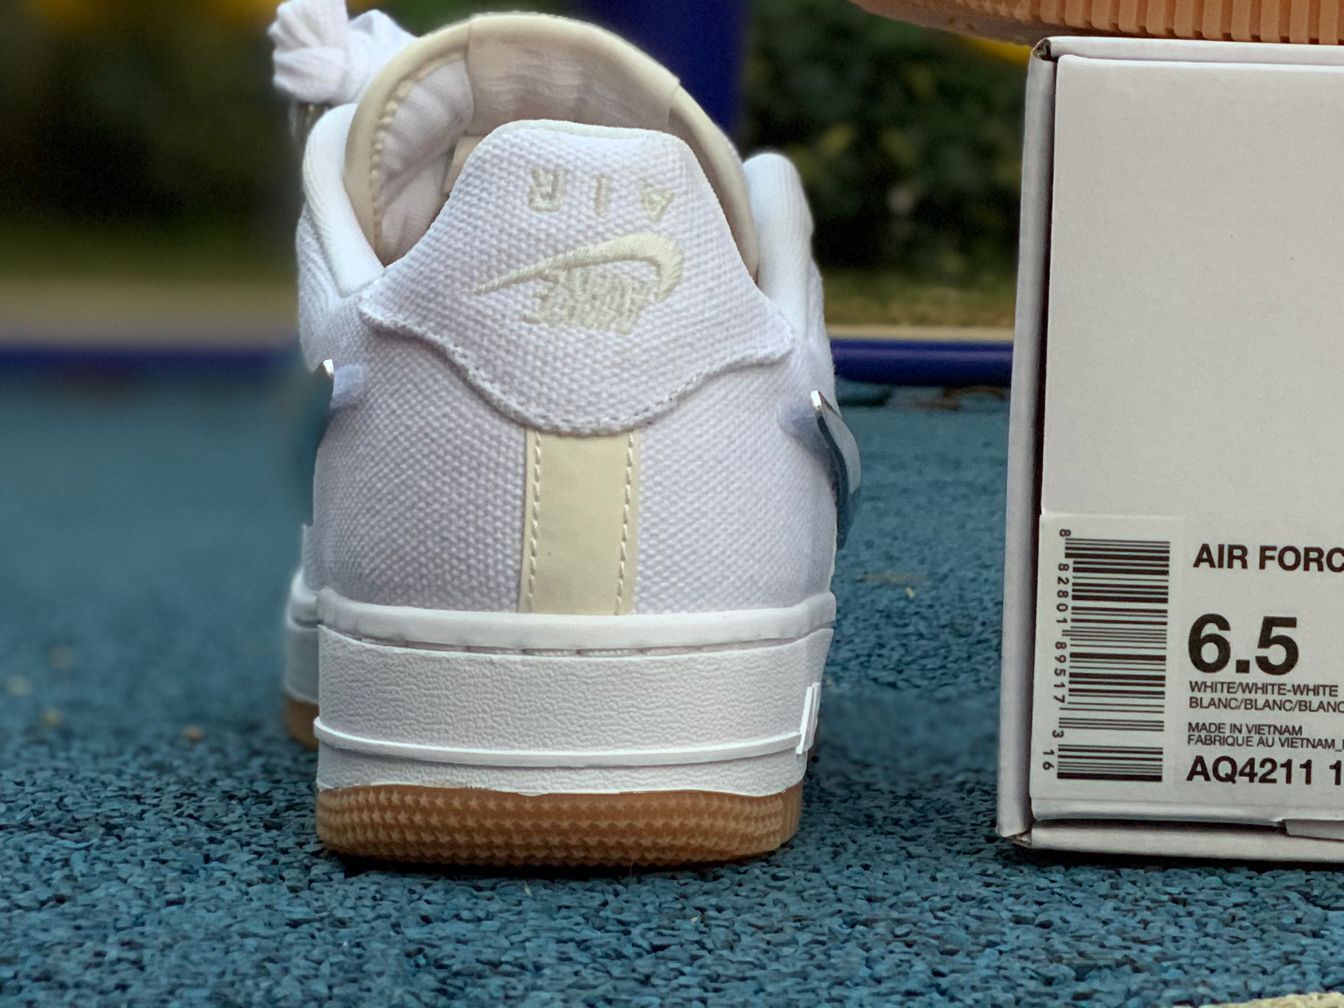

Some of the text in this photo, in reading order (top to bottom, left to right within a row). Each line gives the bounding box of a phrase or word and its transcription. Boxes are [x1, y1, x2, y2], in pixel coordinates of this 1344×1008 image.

[526, 165, 675, 222] AIR
[1192, 543, 1249, 570] AIR
[1187, 613, 1300, 676] 6.5
[1188, 680, 1339, 697] WHITE/WHITE-WHITE
[1187, 721, 1303, 736] MADE IN VIETNAM
[1187, 735, 1254, 748] FABRIQUE
[1256, 735, 1275, 748] AU
[1186, 755, 1313, 786] AQ4211
